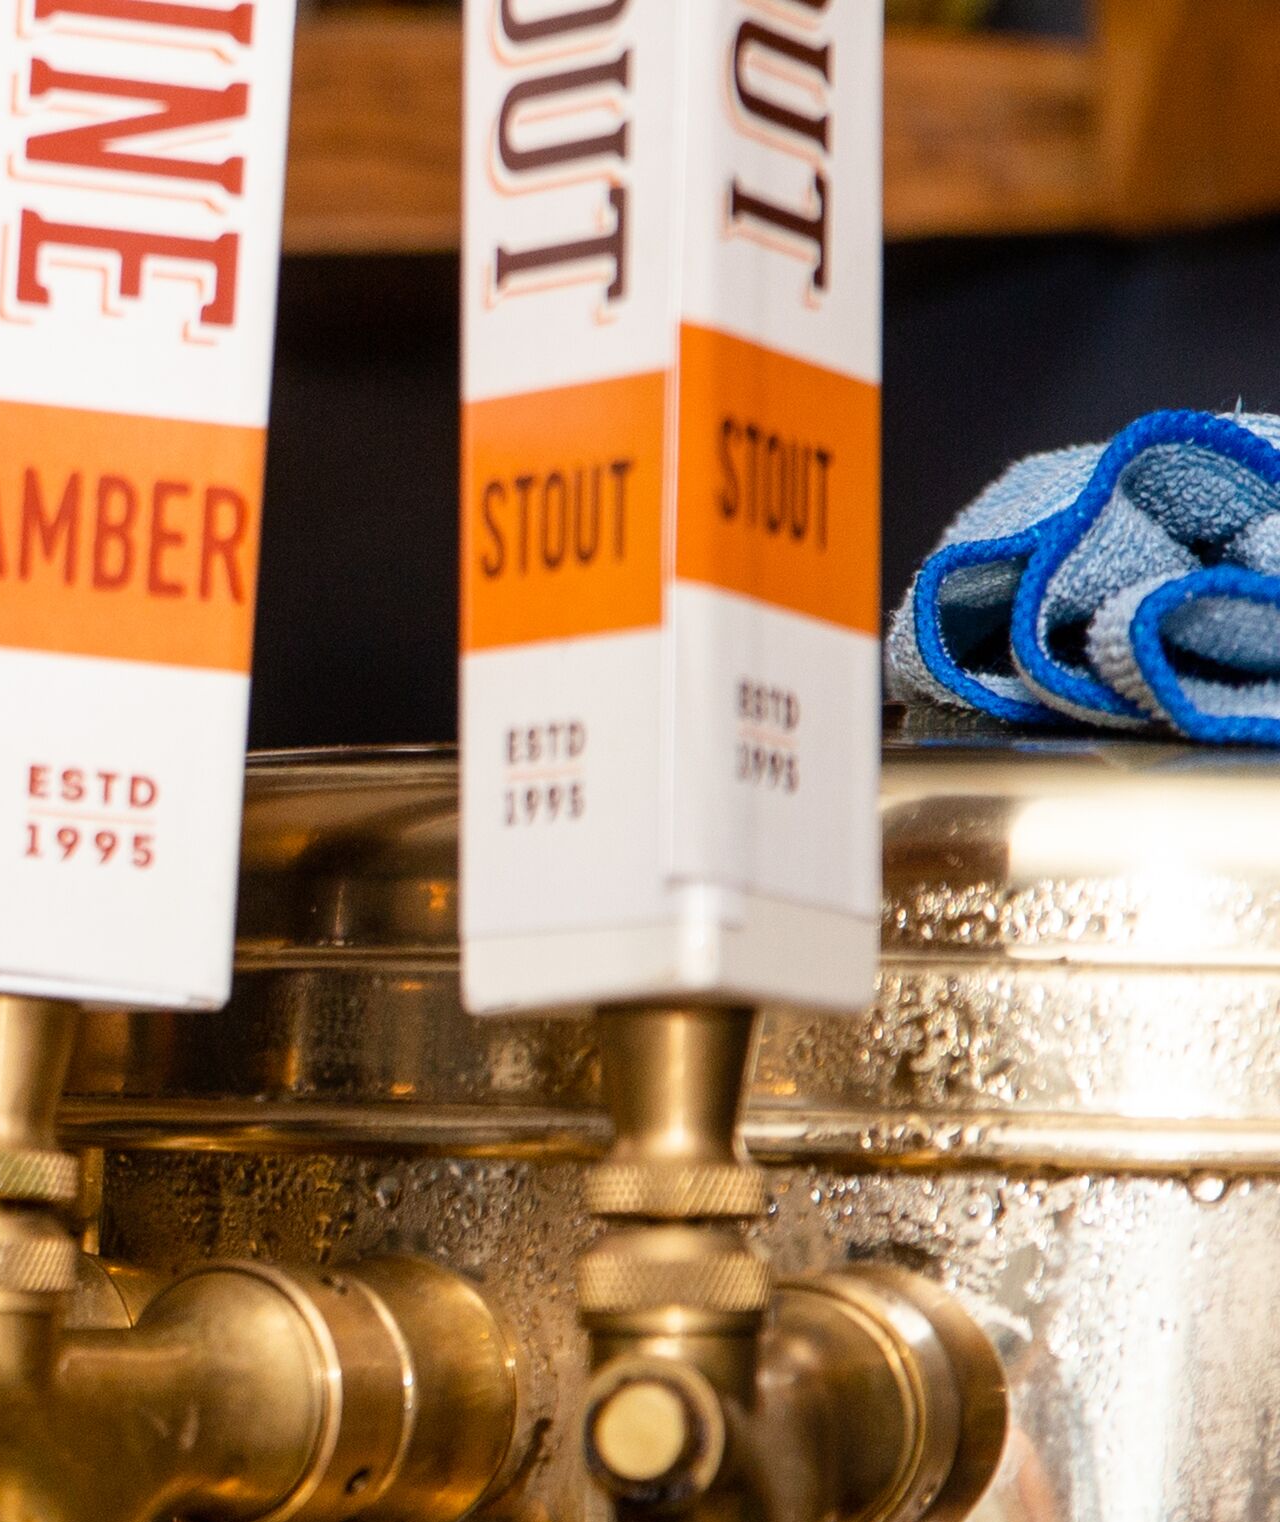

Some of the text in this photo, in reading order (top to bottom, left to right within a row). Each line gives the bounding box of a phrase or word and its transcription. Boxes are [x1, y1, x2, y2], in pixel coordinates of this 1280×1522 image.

[730, 0, 831, 294] UT
[716, 416, 832, 551] STOUT
[481, 458, 633, 578] STOUT
[738, 678, 801, 730] ESTD
[505, 720, 587, 766] ESTD
[28, 764, 160, 809] ESTD
[503, 782, 586, 829] 1995
[25, 823, 156, 870] 1995
